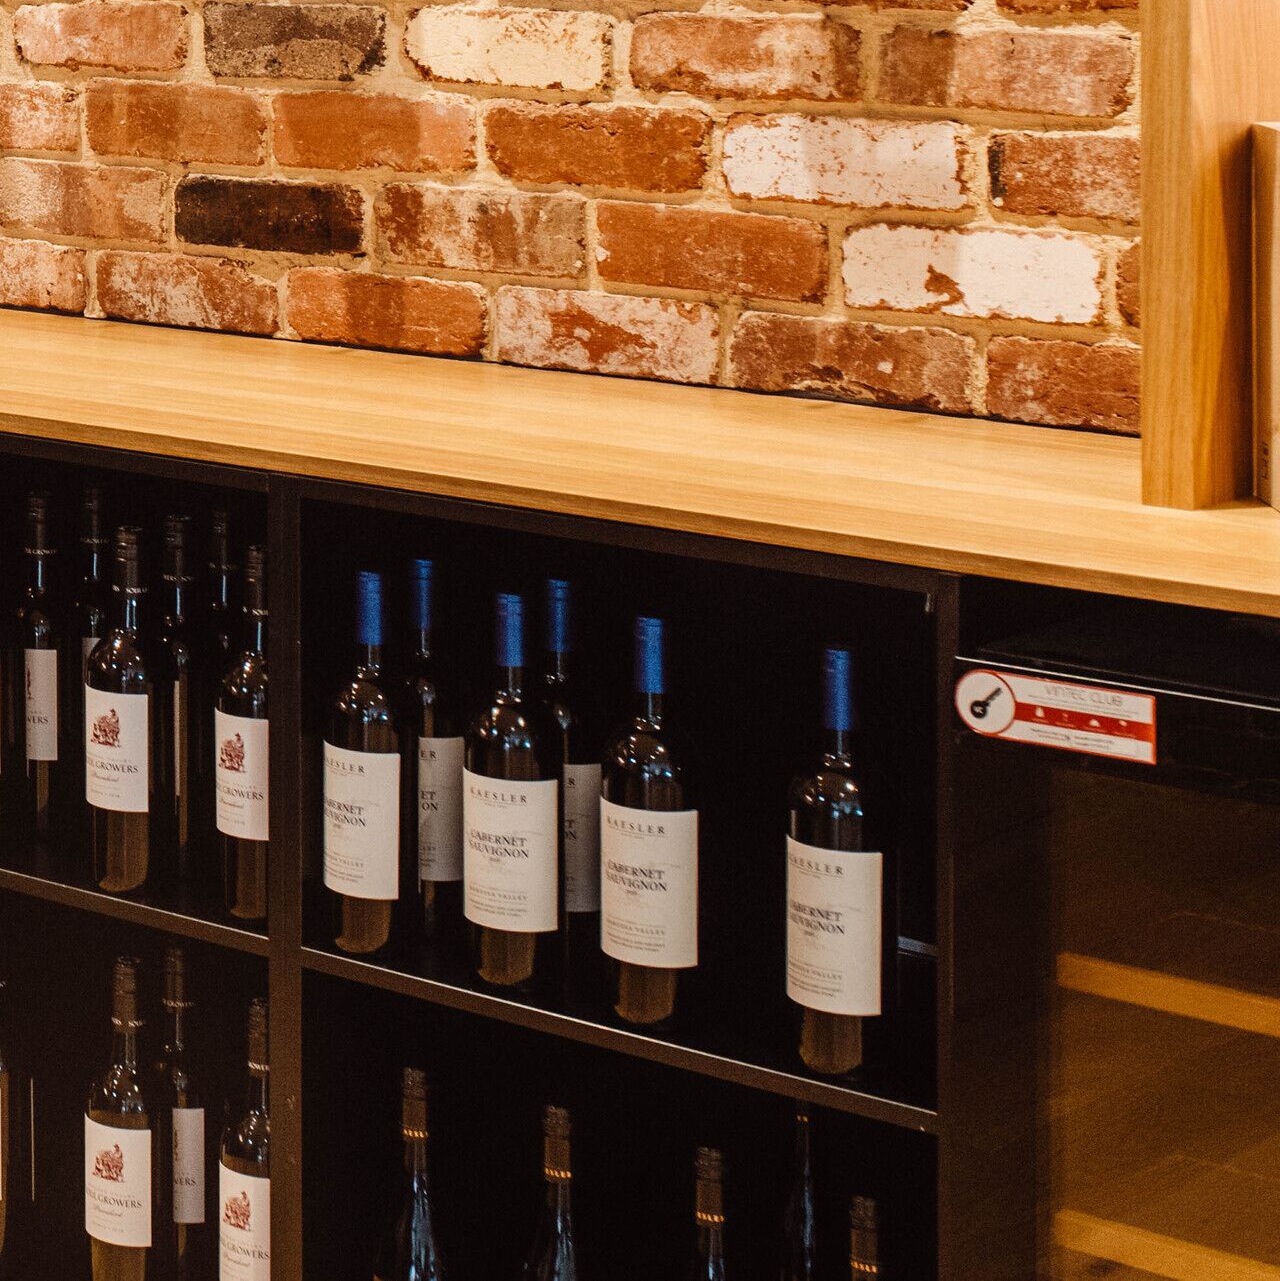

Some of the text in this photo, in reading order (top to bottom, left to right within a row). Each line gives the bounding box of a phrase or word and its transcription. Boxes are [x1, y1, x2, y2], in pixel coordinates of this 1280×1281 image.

[96, 762, 138, 774] GROWERS
[470, 787, 527, 803] KAESLER
[606, 815, 665, 834] KAESLER
[470, 829, 528, 847] CABERNET
[468, 839, 529, 859] SAUVIGNON
[608, 859, 664, 879] CABERNET
[606, 871, 667, 892] SAUVIGNON
